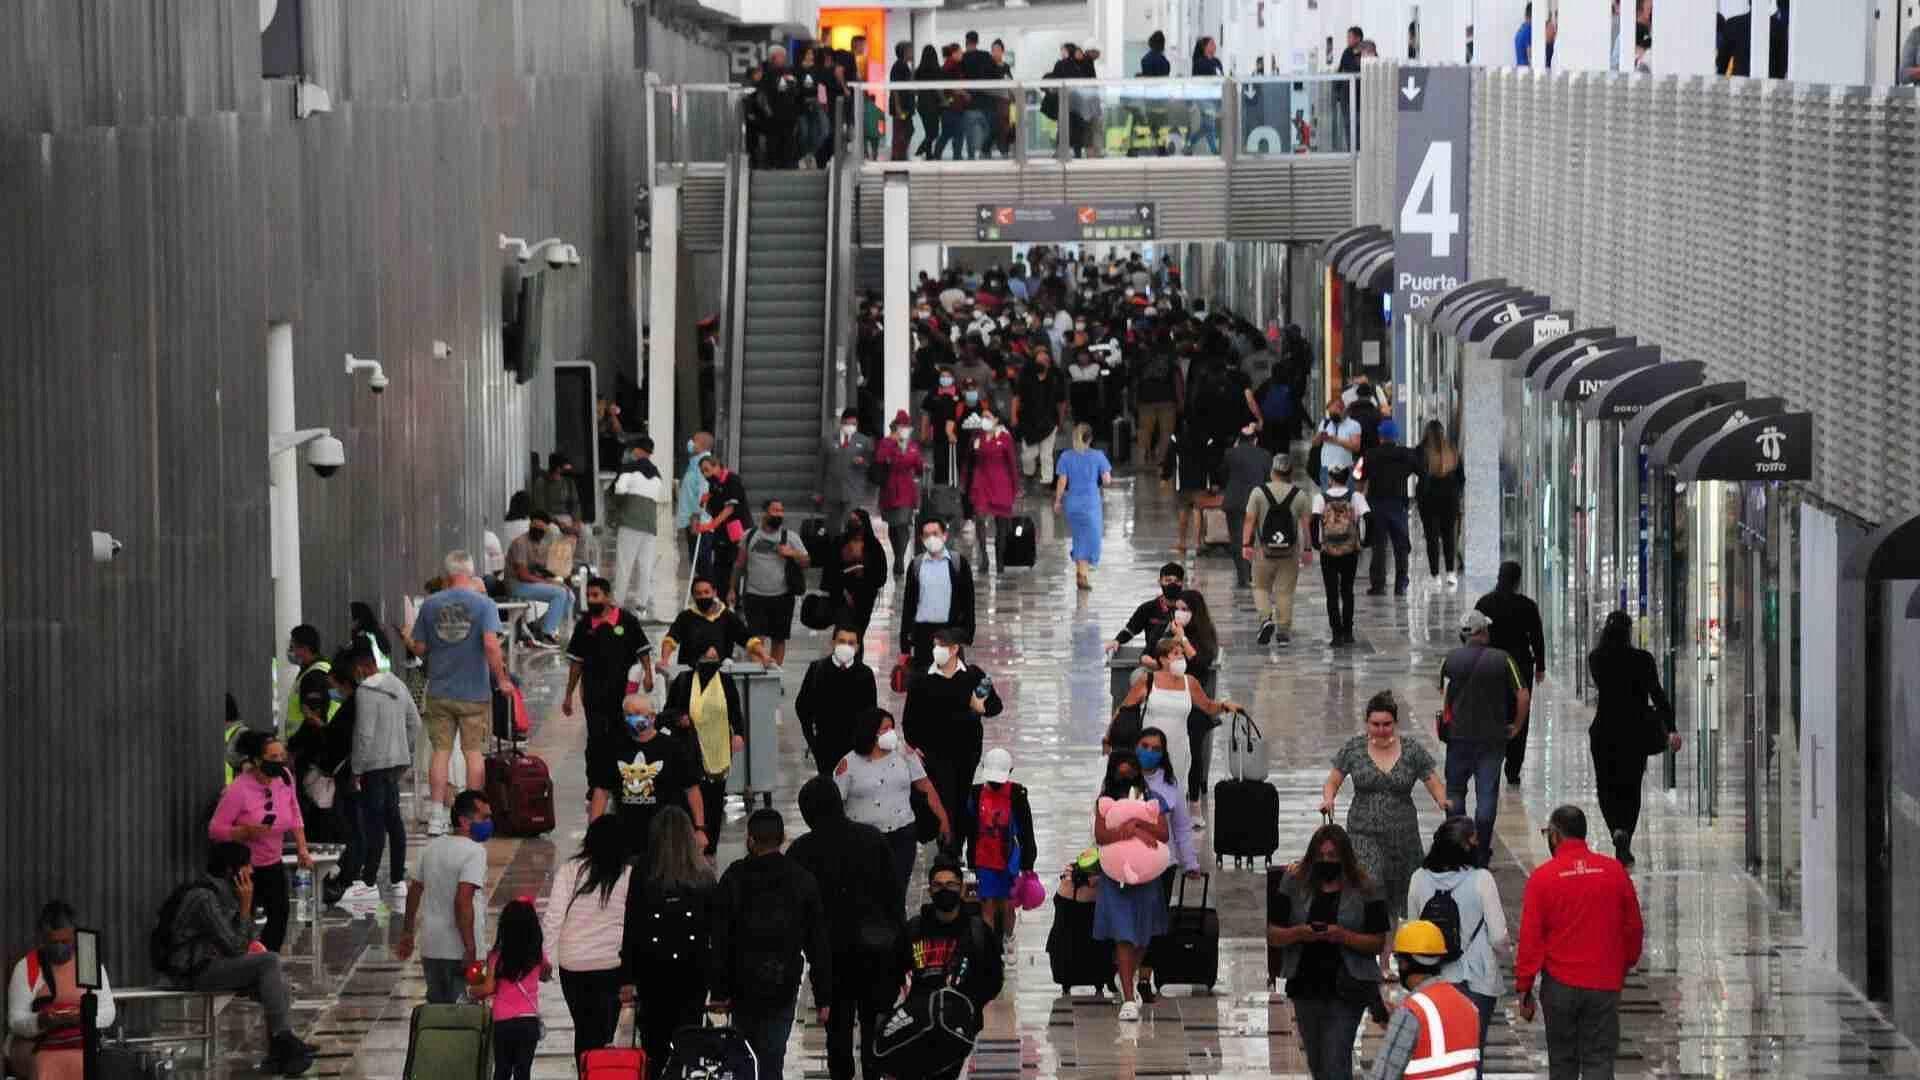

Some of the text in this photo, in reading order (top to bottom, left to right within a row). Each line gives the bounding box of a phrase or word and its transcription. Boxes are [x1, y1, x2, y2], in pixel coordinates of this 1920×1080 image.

[1401, 141, 1458, 256] 4
[1399, 272, 1457, 290] Puerta
[1579, 380, 1608, 395] IN
[1755, 462, 1787, 473] TOTTO
